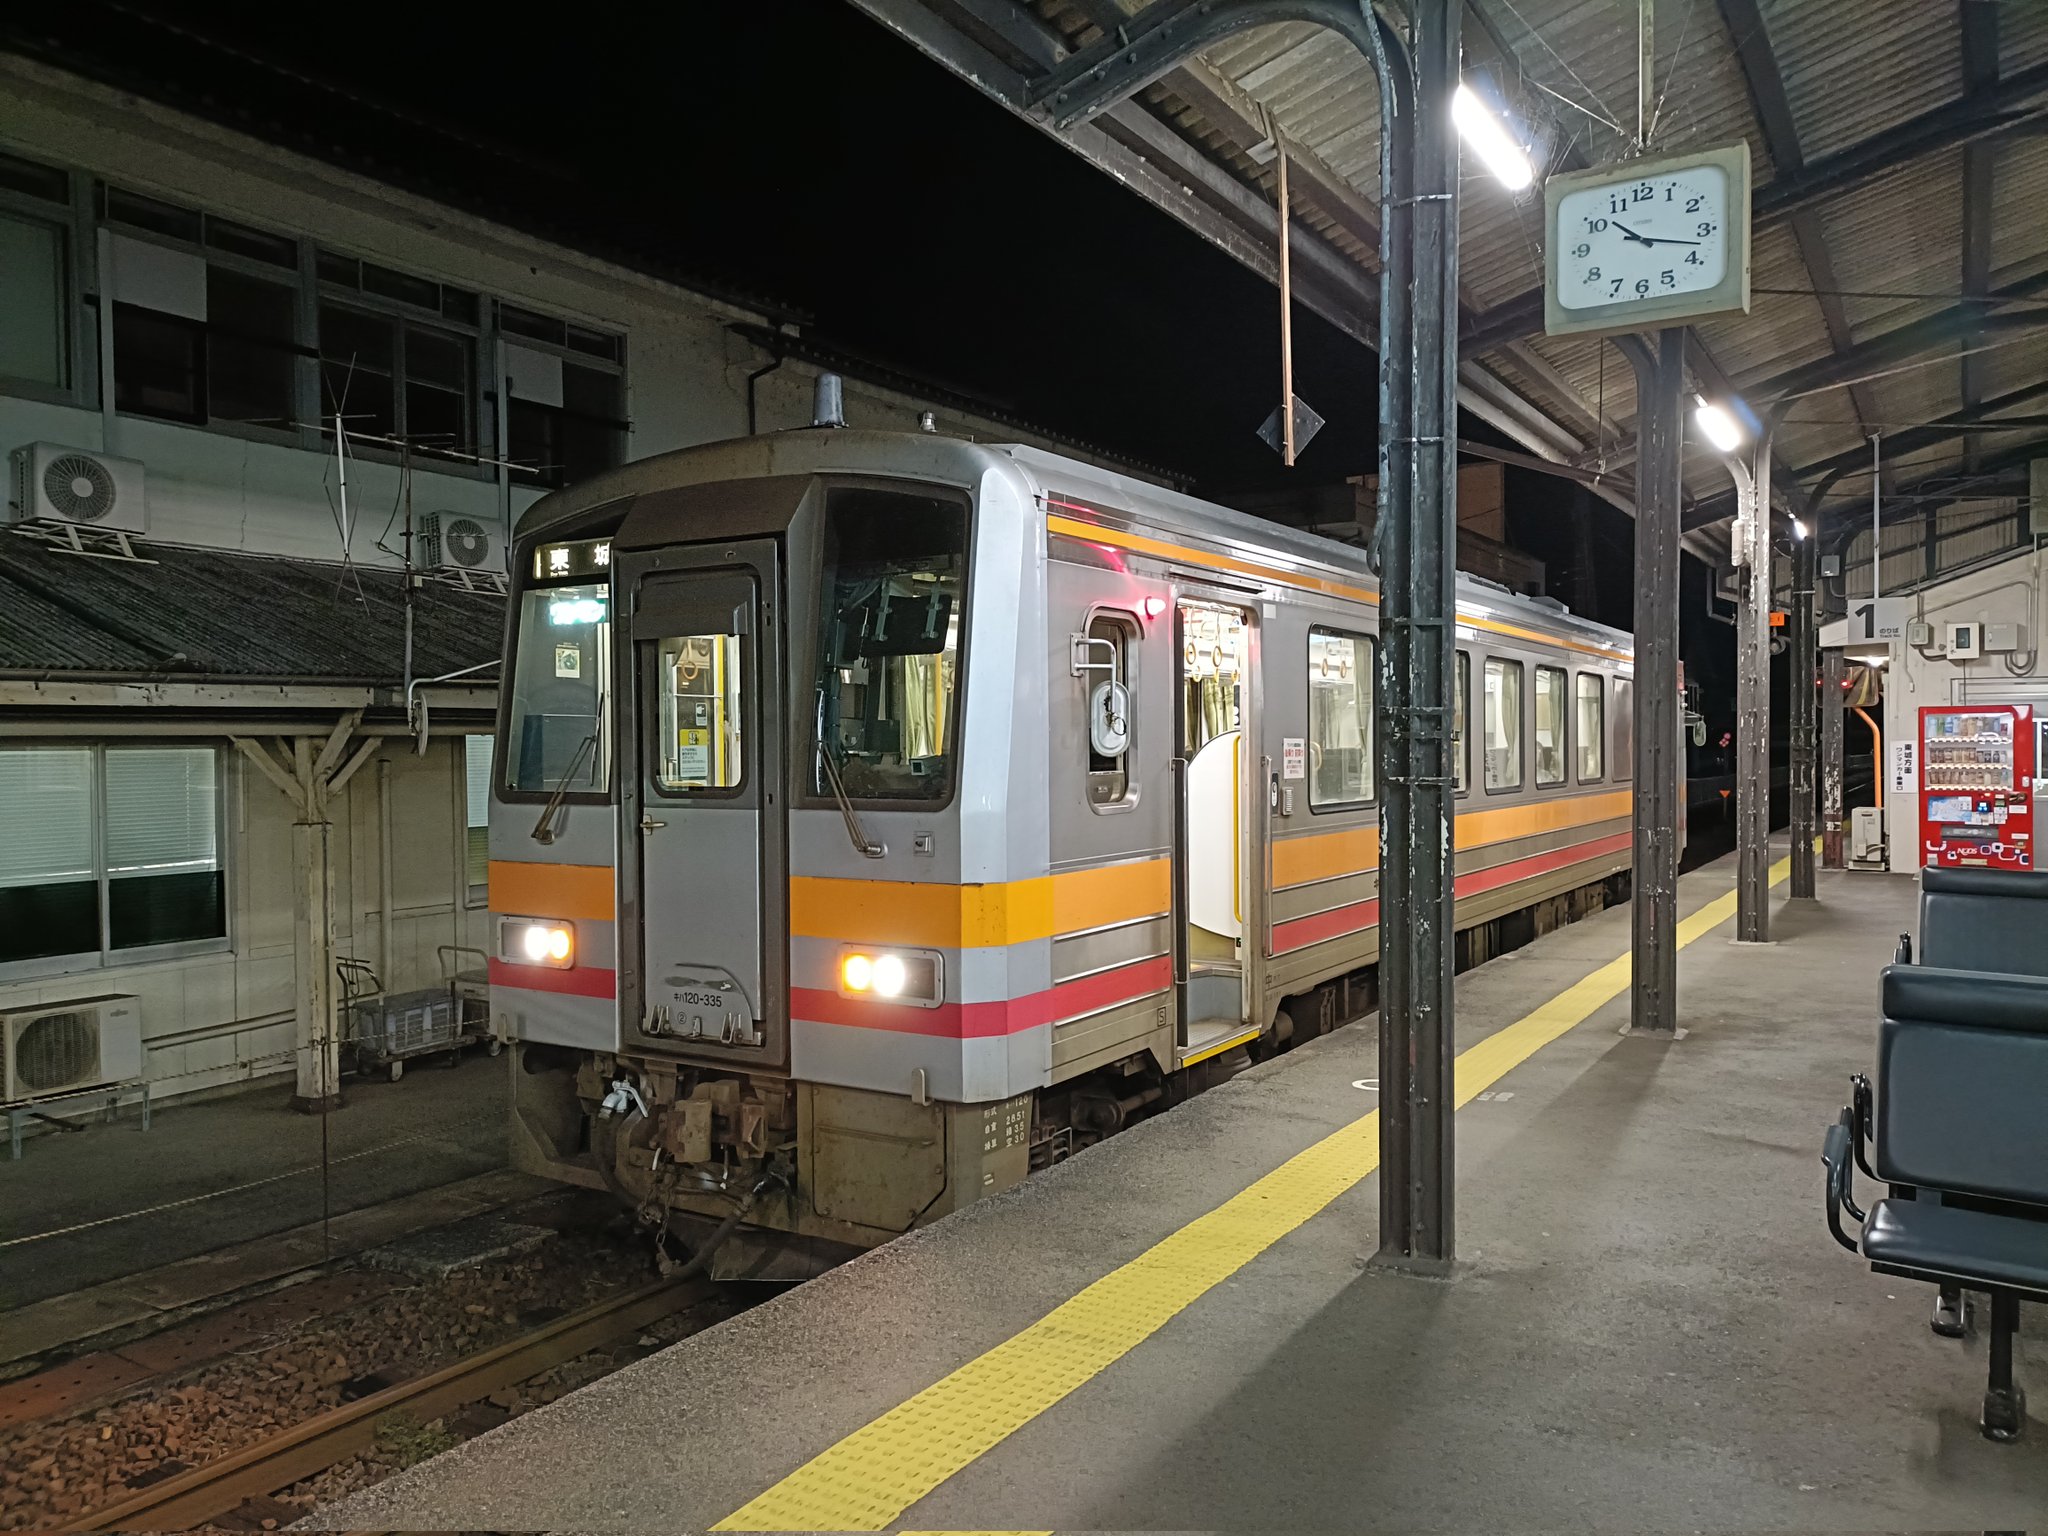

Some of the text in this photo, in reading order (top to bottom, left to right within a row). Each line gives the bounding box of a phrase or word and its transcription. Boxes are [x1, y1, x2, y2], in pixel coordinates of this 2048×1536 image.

[1632, 186, 1653, 202] 12
[1665, 188, 1673, 202] 1
[1610, 198, 1628, 214] 11
[1685, 198, 1700, 213] 2
[1587, 218, 1608, 234] 10
[1696, 222, 1711, 237] 3
[1576, 243, 1591, 258] 9
[1684, 250, 1699, 265] 4
[1587, 267, 1601, 281] 8
[1660, 269, 1675, 285] 5
[1610, 278, 1624, 293] 7
[1635, 279, 1649, 293] 6
[1855, 603, 1875, 639] 1
[1904, 743, 1912, 774] 東城方面
[1158, 1008, 1166, 1024] S
